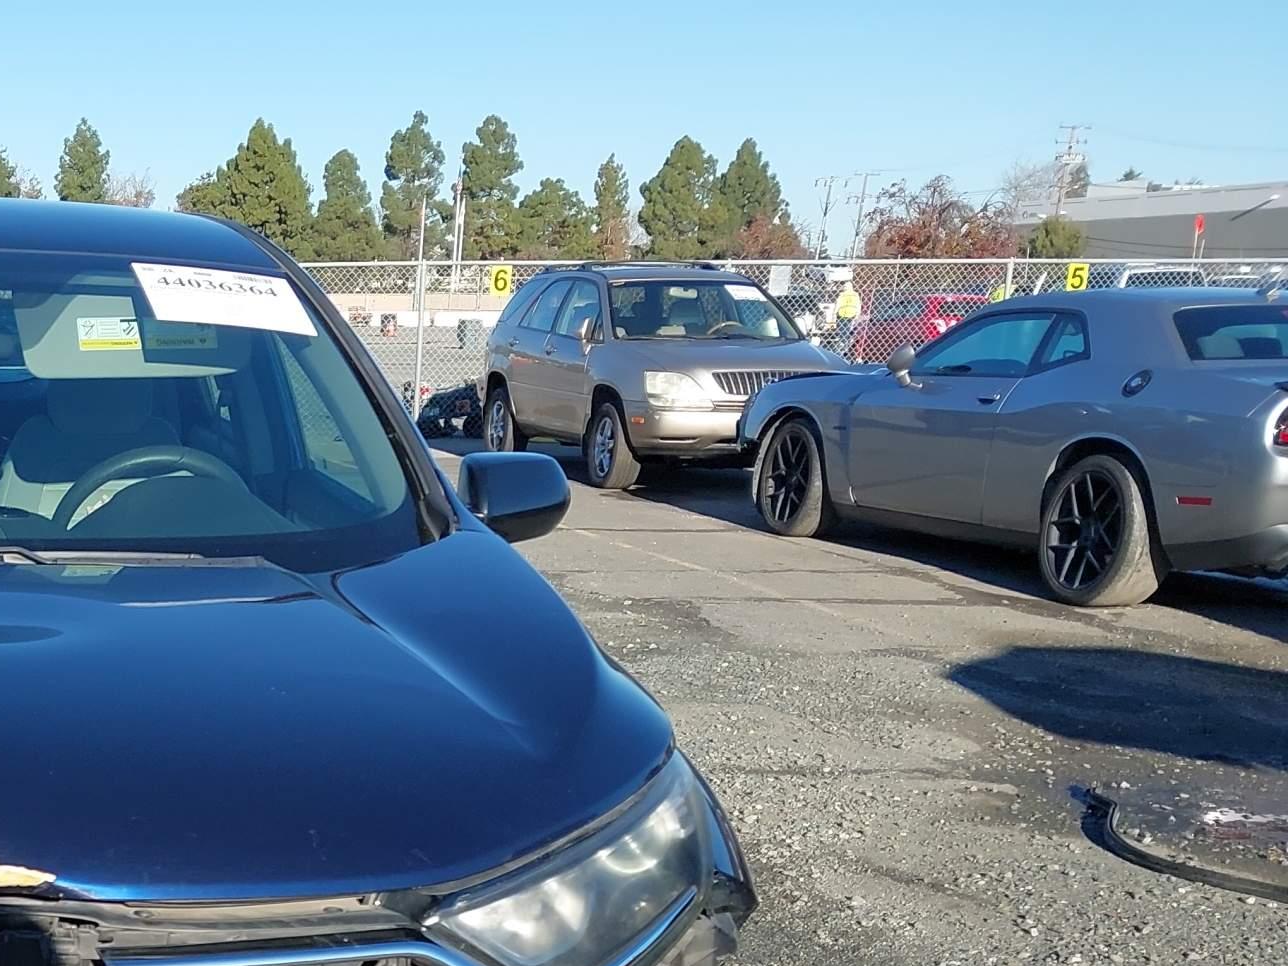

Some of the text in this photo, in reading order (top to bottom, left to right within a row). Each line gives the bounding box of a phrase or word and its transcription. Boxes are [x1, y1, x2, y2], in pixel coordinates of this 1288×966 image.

[157, 275, 278, 297] 44036364
[494, 269, 508, 292] 6
[1070, 266, 1085, 289] 5
